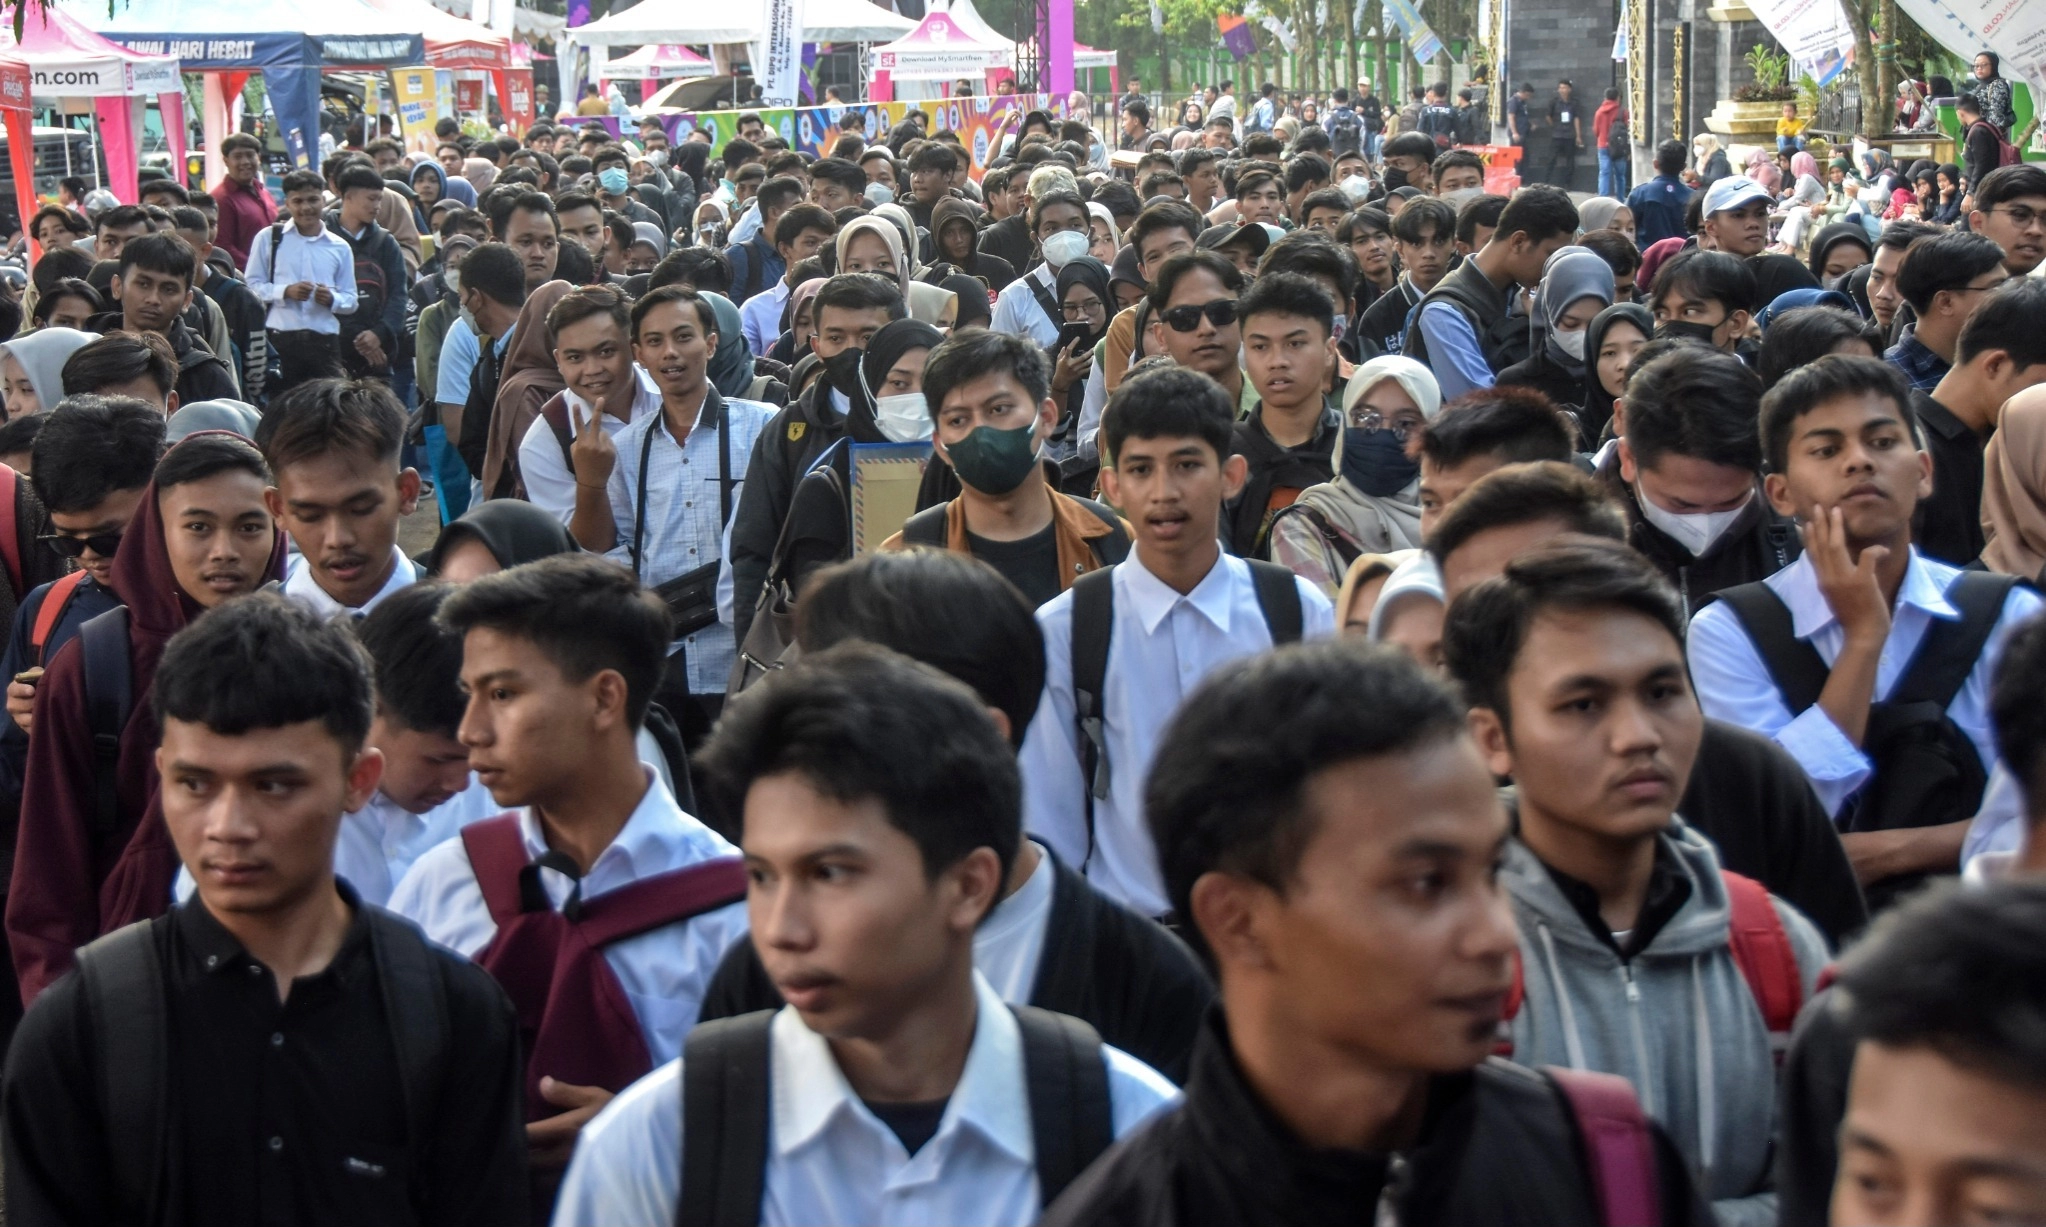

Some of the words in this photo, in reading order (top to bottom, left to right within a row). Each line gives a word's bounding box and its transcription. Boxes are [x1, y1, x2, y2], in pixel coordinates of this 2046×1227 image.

[169, 40, 205, 59] HARI
[207, 40, 255, 60] HEBAT
[768, 56, 776, 75] DIPO
[938, 55, 982, 63] MySmartfren
[30, 70, 99, 86] n.com
